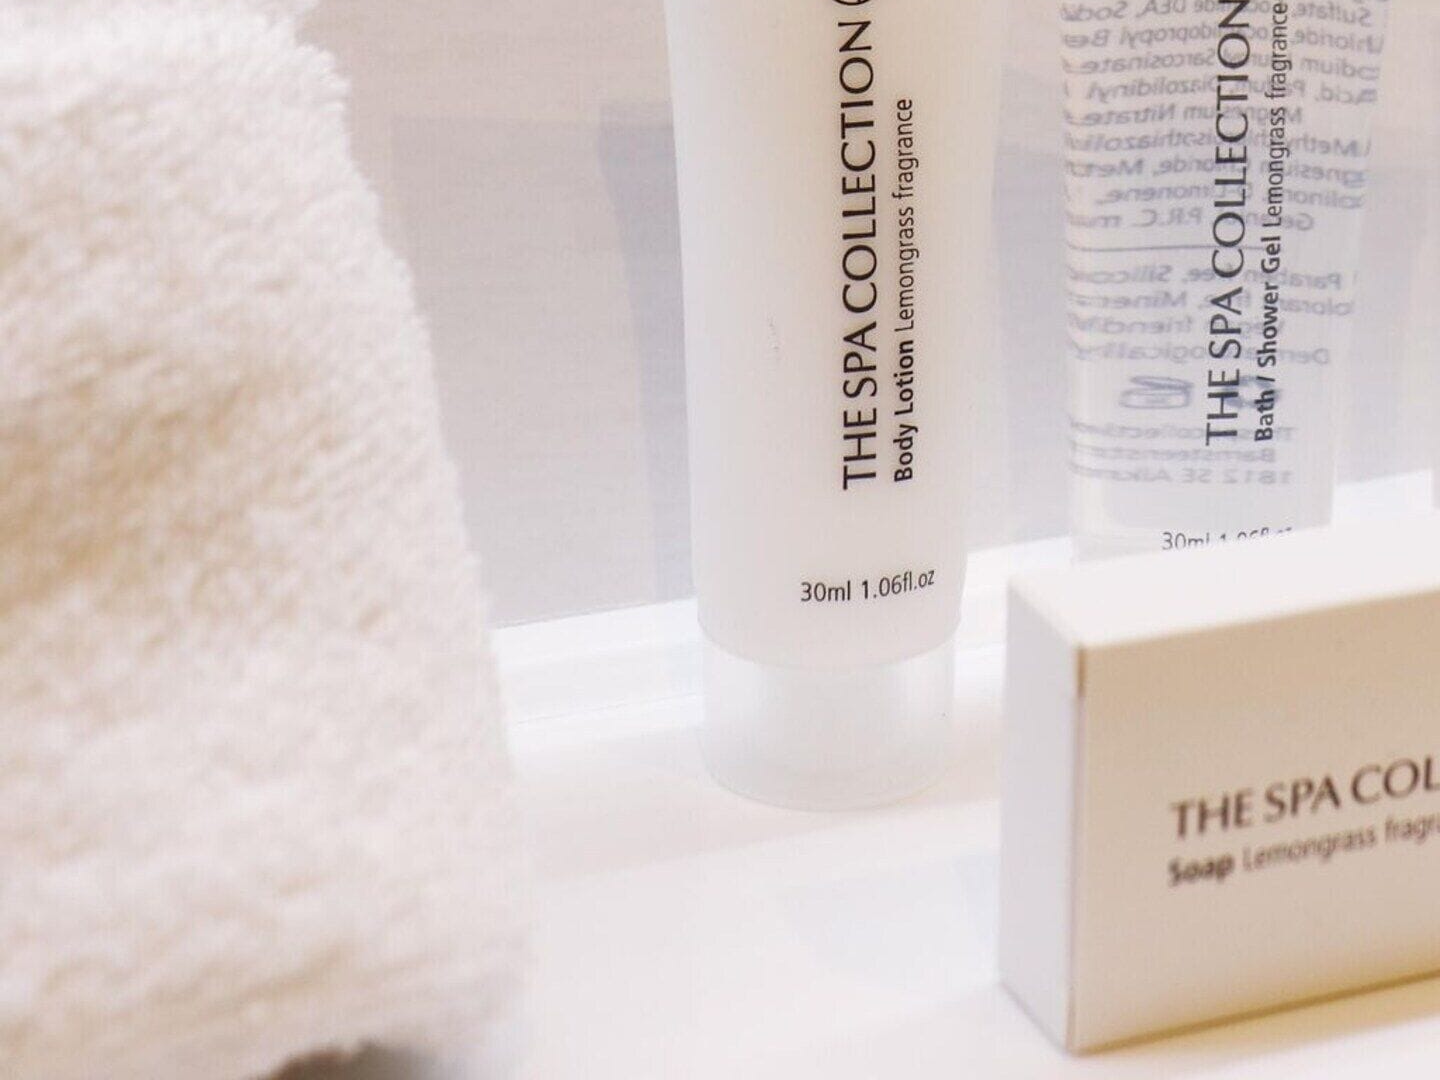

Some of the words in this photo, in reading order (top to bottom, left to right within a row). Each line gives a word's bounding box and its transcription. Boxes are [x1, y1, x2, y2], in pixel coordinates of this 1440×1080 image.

[1264, 2, 1292, 100] fragrance
[837, 19, 878, 315] COLLECTION
[890, 98, 920, 202] fragrance
[1262, 106, 1291, 229] Lemongrass
[893, 206, 921, 333] Lemongrass
[1261, 236, 1281, 274] Gel
[842, 319, 879, 401] SPA
[1208, 286, 1243, 359] SPA
[1256, 281, 1279, 368] Shower
[892, 339, 915, 417] Lotion
[1206, 369, 1241, 445] THE
[1253, 389, 1276, 442] Bath
[842, 406, 879, 491] THE
[892, 422, 920, 484] Body
[799, 579, 853, 604] 30ml
[861, 568, 936, 600] 1.06fl.oz
[1169, 787, 1256, 841] THE
[1262, 774, 1342, 824] SPA
[1167, 851, 1236, 888] Soap
[1242, 823, 1378, 873] Lemongrass
